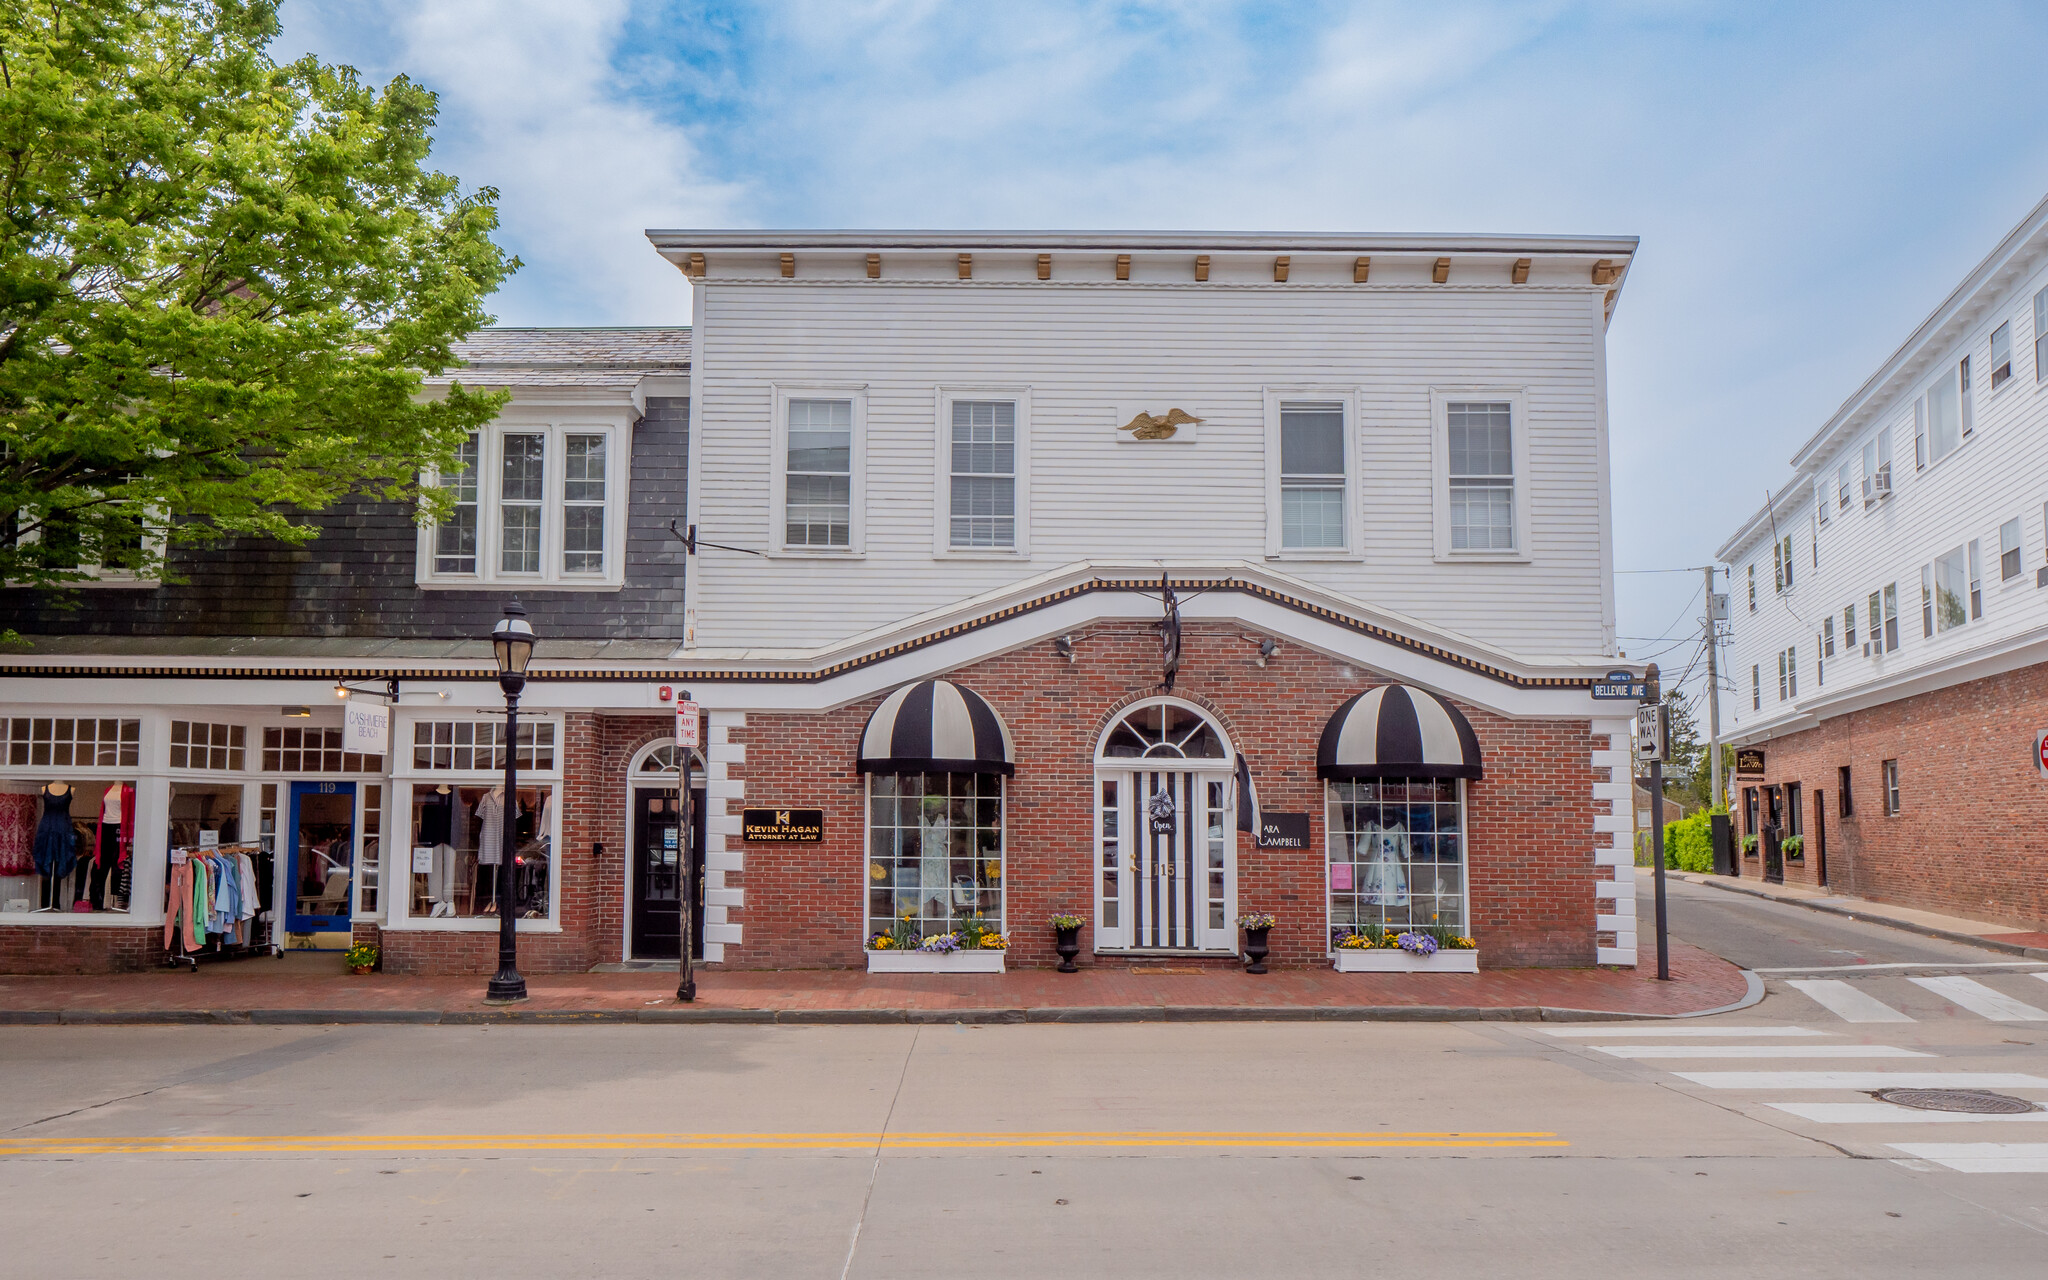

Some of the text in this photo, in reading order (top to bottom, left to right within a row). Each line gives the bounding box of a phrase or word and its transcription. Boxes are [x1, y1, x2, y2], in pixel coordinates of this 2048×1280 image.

[1595, 685, 1645, 696] BELLEVUE AVE
[348, 711, 388, 729] CASHMERE
[681, 717, 695, 727] ANY
[1640, 709, 1657, 724] ONE
[358, 726, 379, 738] BEACH
[680, 729, 695, 739] TIME
[1640, 725, 1657, 739] WAY
[319, 782, 336, 793] 119
[746, 825, 820, 833] KEVIN HAGAN
[1154, 820, 1172, 832] Open
[1263, 824, 1280, 834] ARA
[1258, 835, 1301, 847] CAMPBELL
[1154, 863, 1175, 876] 115
